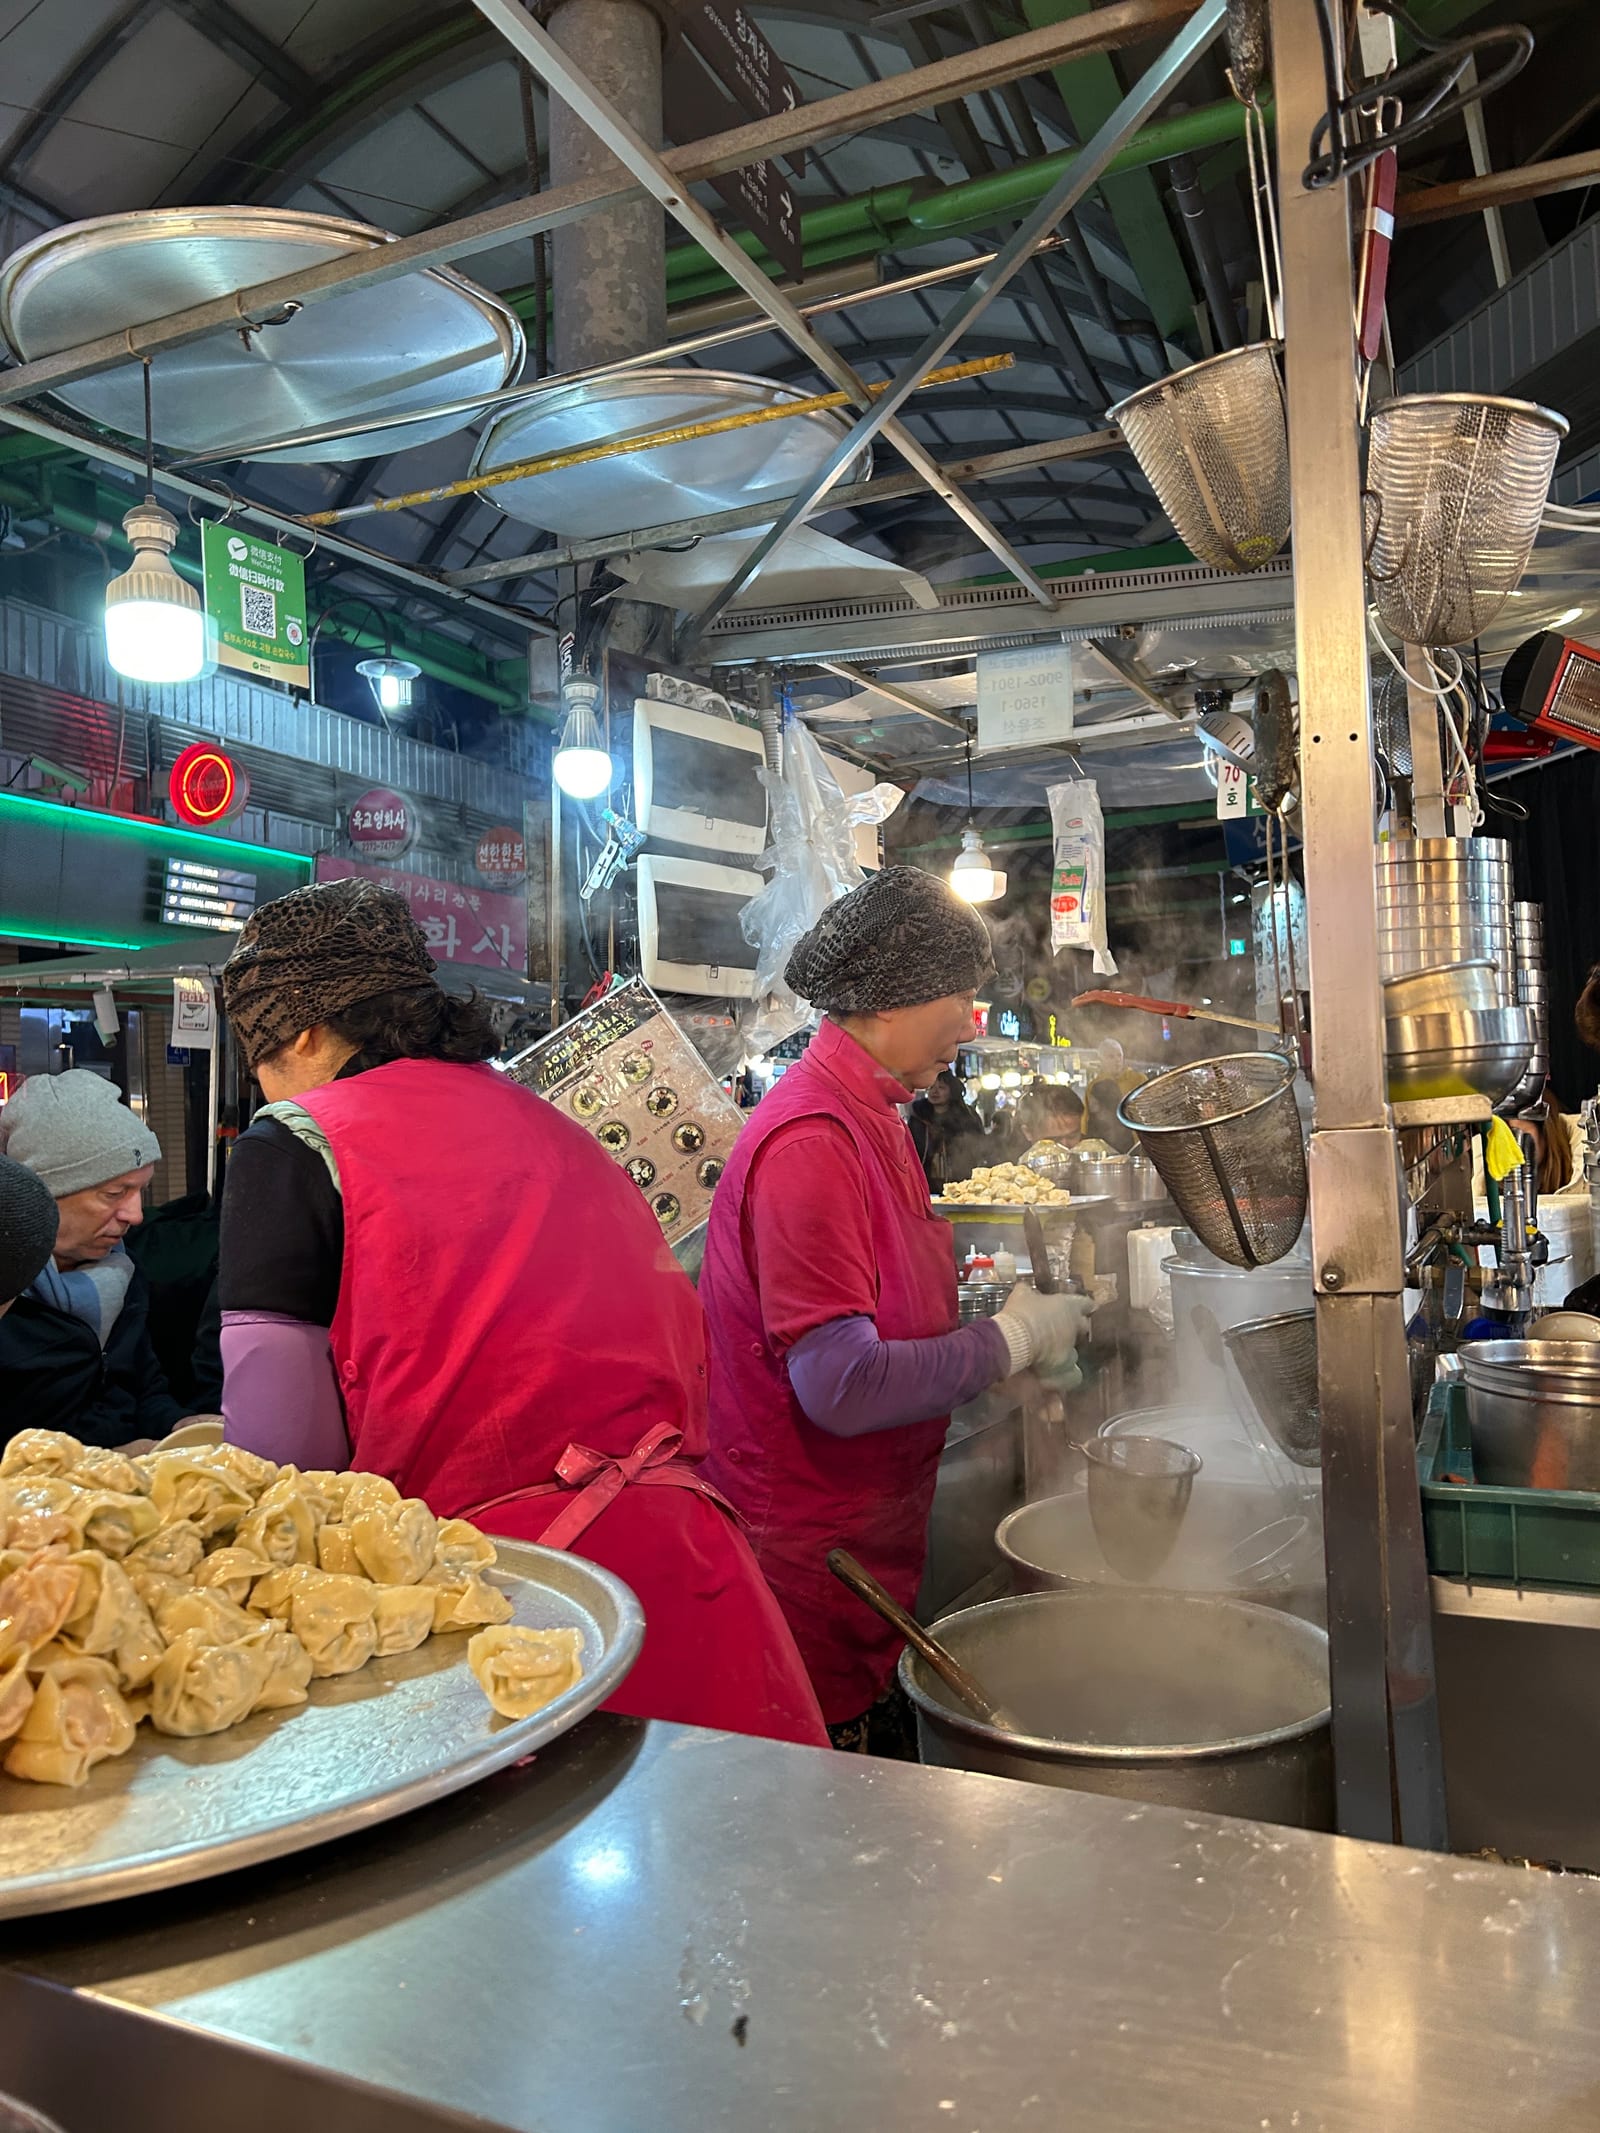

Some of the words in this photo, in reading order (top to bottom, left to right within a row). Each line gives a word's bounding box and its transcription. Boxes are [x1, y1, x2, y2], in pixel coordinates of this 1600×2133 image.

[250, 545, 282, 566] 微信支付
[228, 562, 285, 593] 微信扫码付款
[272, 565, 283, 576] Pay
[1224, 765, 1240, 784] 70
[1226, 787, 1238, 806] 호
[181, 992, 209, 1002] CCTV
[544, 1040, 581, 1069] SOUTH
[582, 1014, 619, 1042] KOREA
